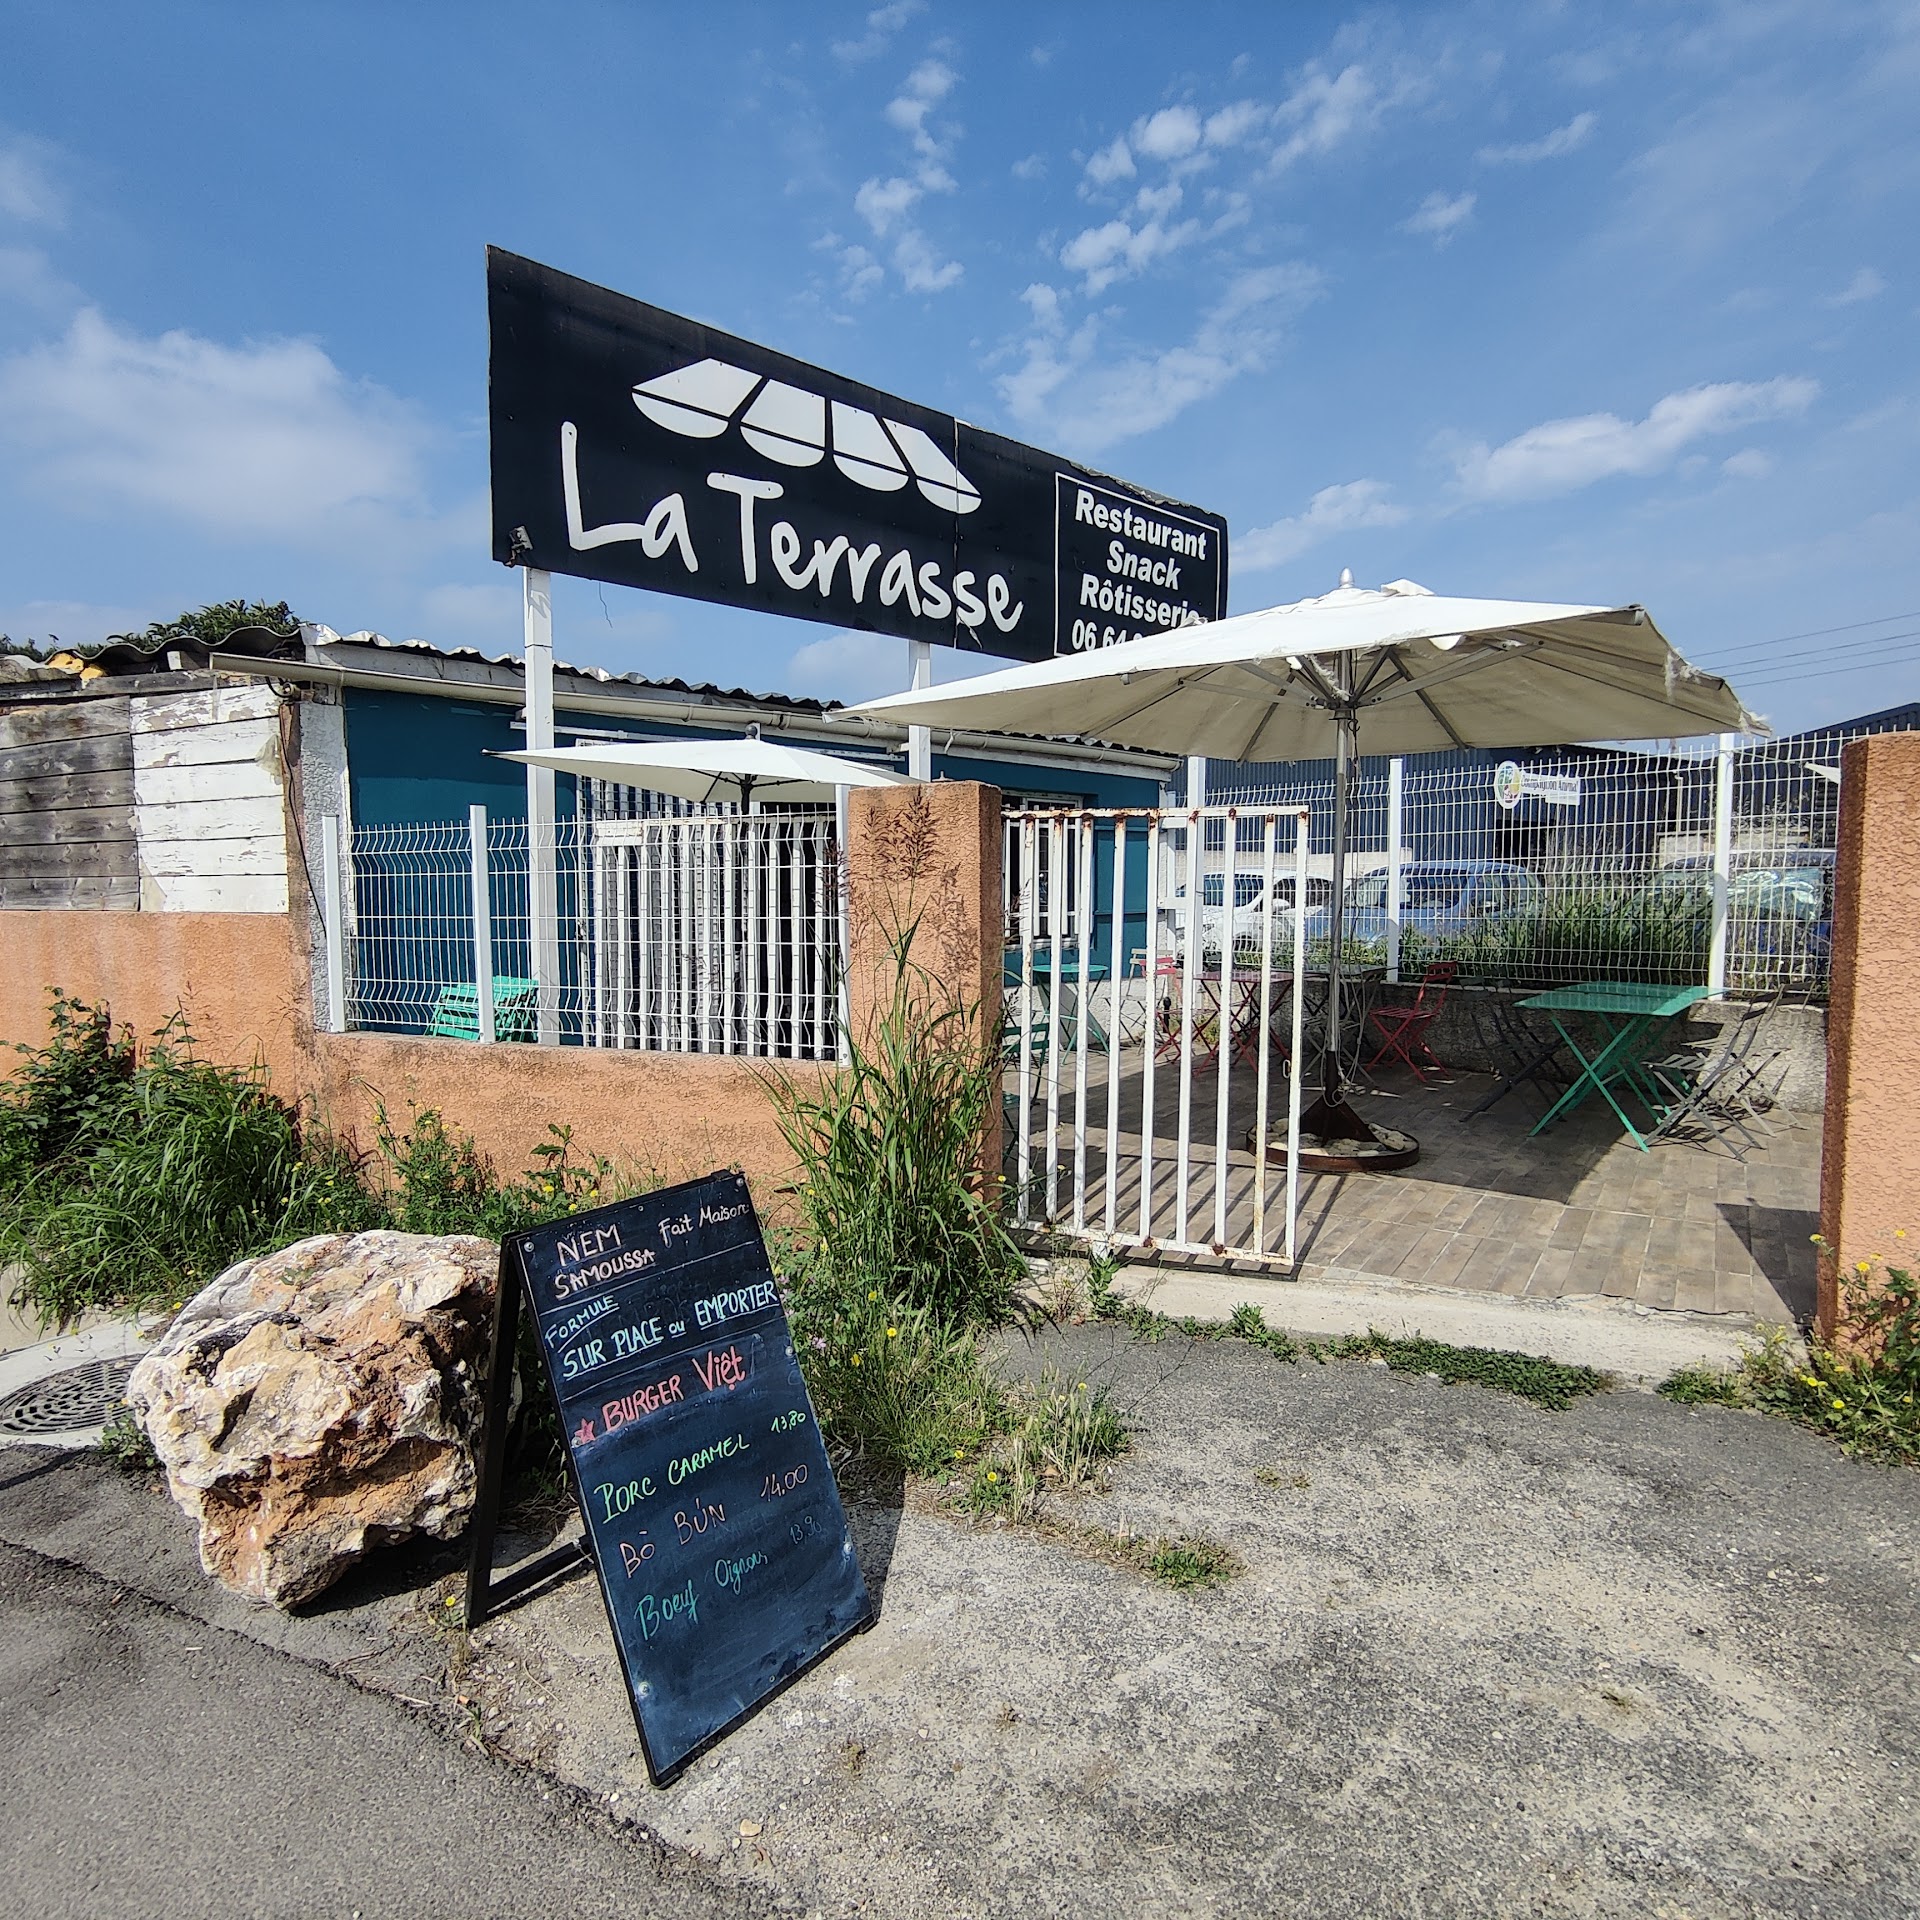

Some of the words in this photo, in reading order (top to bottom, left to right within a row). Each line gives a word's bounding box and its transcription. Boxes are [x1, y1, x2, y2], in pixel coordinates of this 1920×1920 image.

[561, 421, 700, 573] La
[706, 471, 1025, 634] Terrasse
[1075, 489, 1207, 561] Restaurant
[1106, 540, 1181, 590] Snack
[1072, 619, 1098, 651] 06
[555, 1224, 621, 1267] NEM
[658, 1215, 694, 1249] Fait
[554, 1248, 656, 1299] SAMOUSSA
[544, 1295, 620, 1349] FORMULE
[562, 1341, 606, 1378] SUR
[611, 1316, 664, 1358] PLACE
[694, 1280, 779, 1326] EMPORTER
[602, 1374, 685, 1430] BURGER
[594, 1477, 657, 1525] PORC
[668, 1433, 751, 1486] CARAMEL
